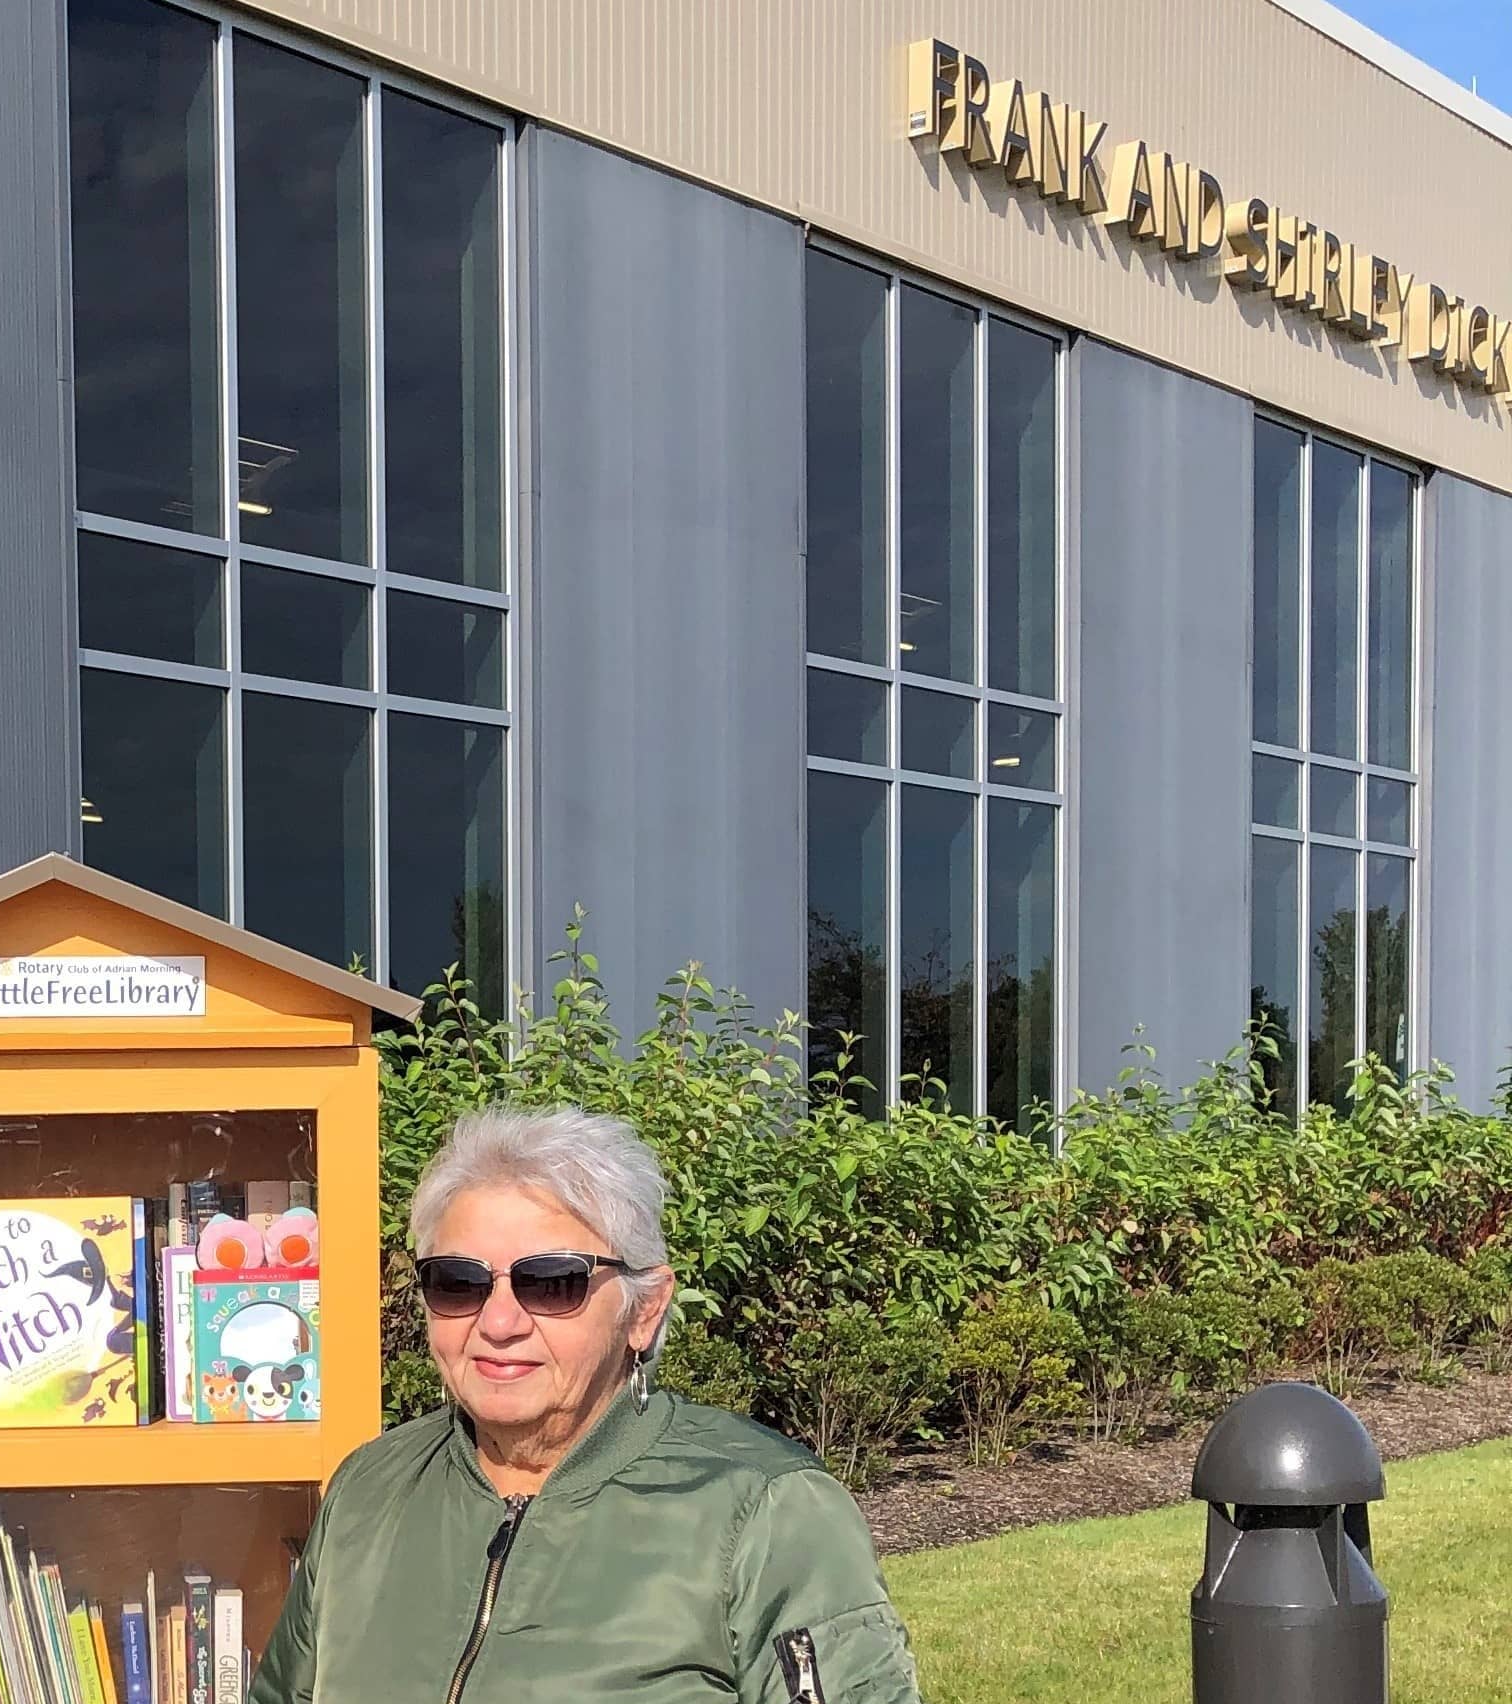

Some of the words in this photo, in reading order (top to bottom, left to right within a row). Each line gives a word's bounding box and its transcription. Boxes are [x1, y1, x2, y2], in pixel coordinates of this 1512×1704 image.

[909, 38, 1107, 214] FRANK
[1105, 140, 1224, 259] AND
[1225, 198, 1414, 346] SHIRLEY
[18, 962, 63, 976] Rotary
[67, 964, 89, 974] Club
[92, 964, 102, 974] of
[105, 964, 137, 973] Adrian
[140, 964, 181, 974] Morning
[6, 1217, 31, 1240] to
[40, 1240, 59, 1264] a
